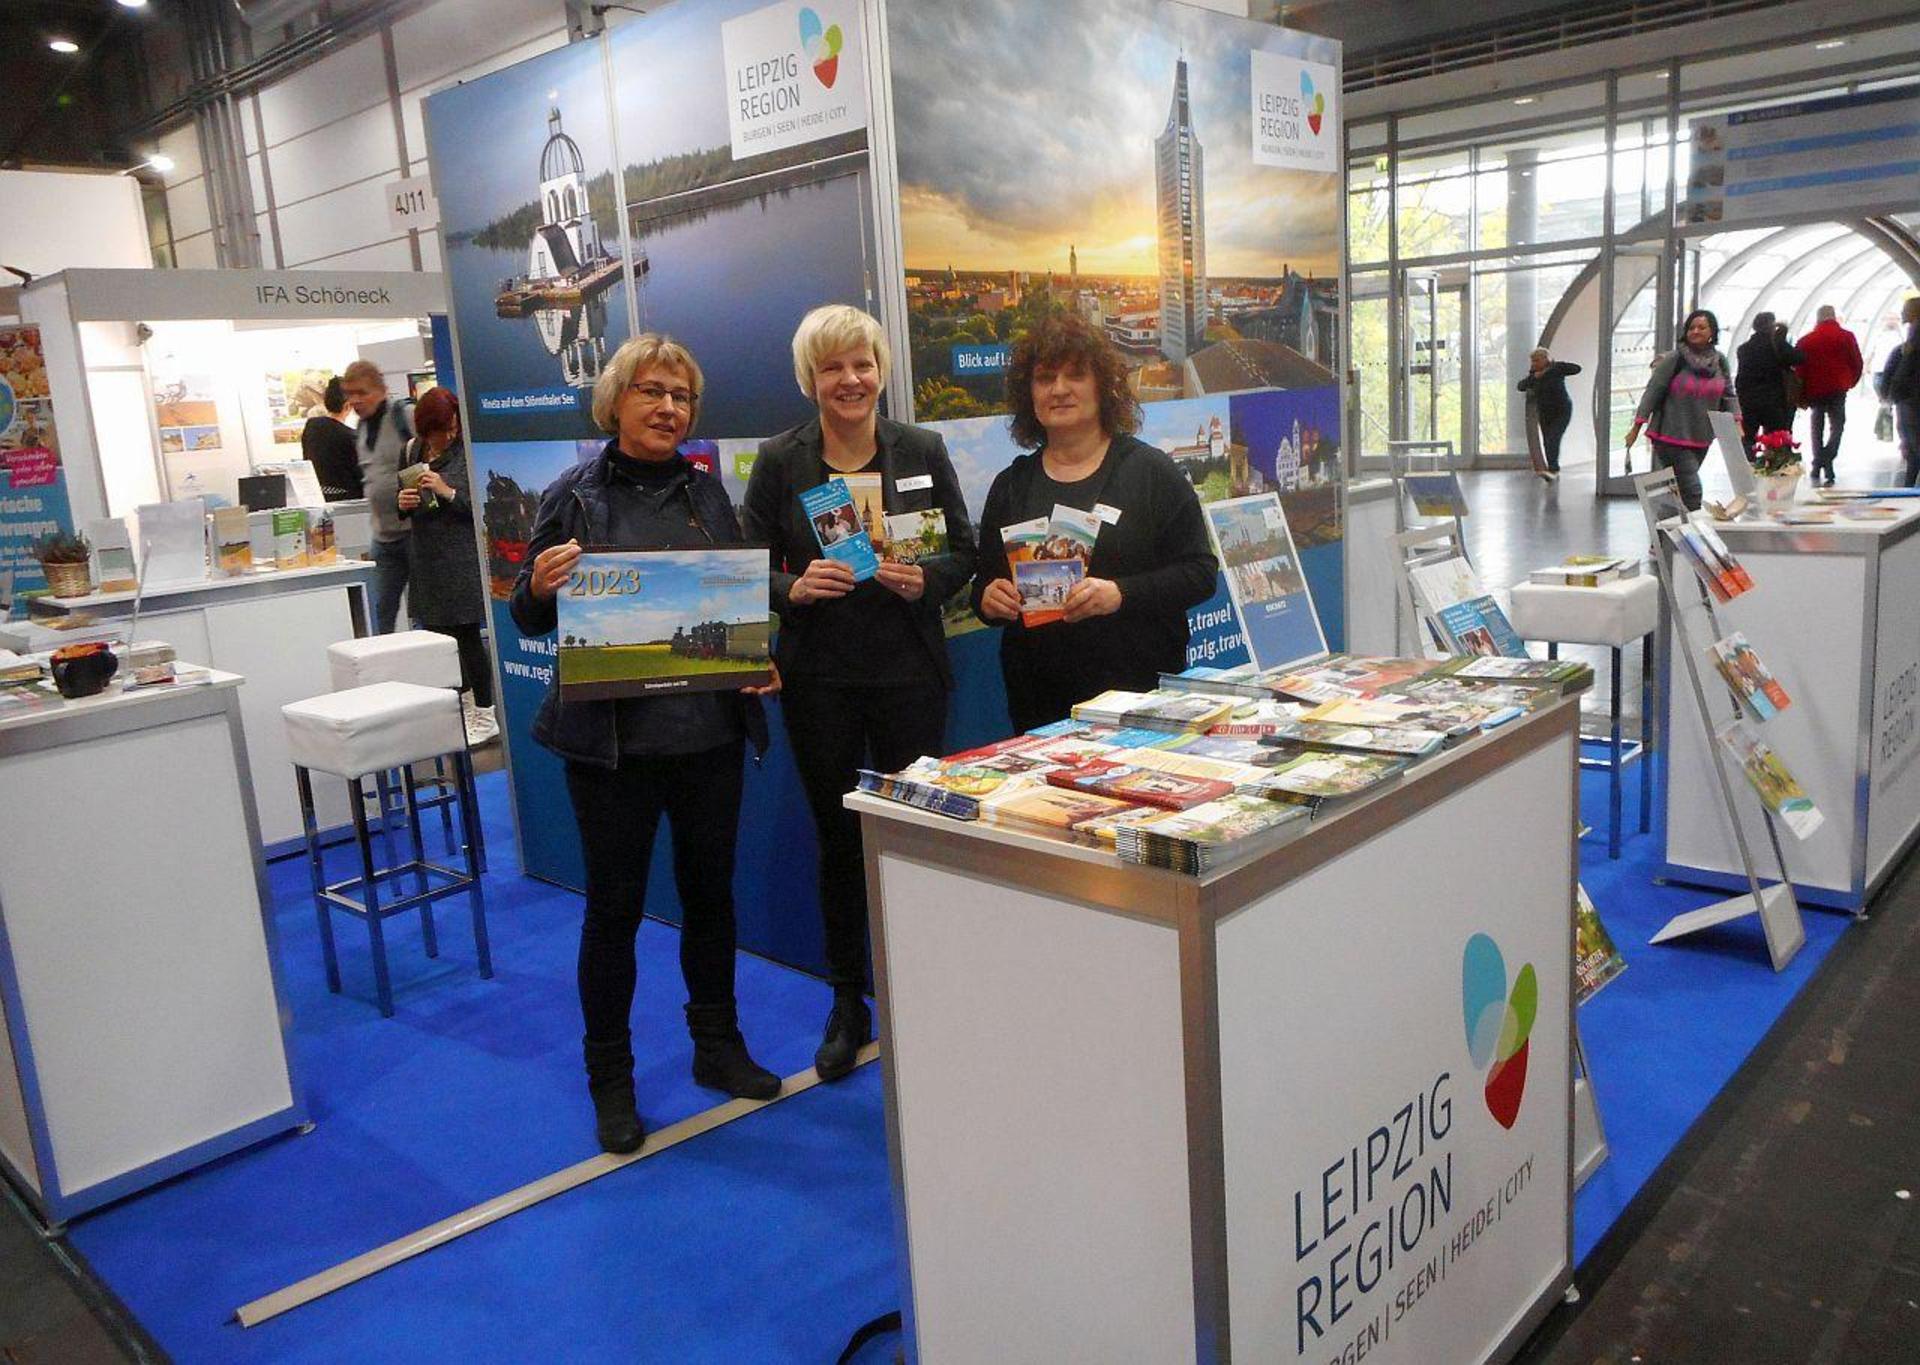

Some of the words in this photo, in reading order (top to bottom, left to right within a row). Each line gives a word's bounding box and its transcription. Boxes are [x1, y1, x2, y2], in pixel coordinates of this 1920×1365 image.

[737, 53, 798, 92] LEIPZIG
[740, 83, 800, 121] REGION
[1259, 93, 1299, 117] LEIPZIG
[777, 119, 796, 134] SEEN
[829, 104, 847, 120] CITY
[1261, 116, 1300, 140] REGION
[395, 189, 426, 215] 4J11
[256, 286, 290, 304] IFA
[295, 286, 391, 304] Schöneck
[958, 352, 983, 368] Blick
[984, 351, 1000, 366] auf
[512, 395, 524, 408] dem
[562, 393, 576, 405] See
[570, 569, 641, 597] 2023
[518, 637, 558, 656] www.le
[1294, 1072, 1452, 1263] LEIPZIG
[1394, 1255, 1438, 1323] SEEN
[1450, 1198, 1495, 1264] HEIDE
[1504, 1153, 1535, 1205] CITY
[1296, 1151, 1452, 1356] REGION
